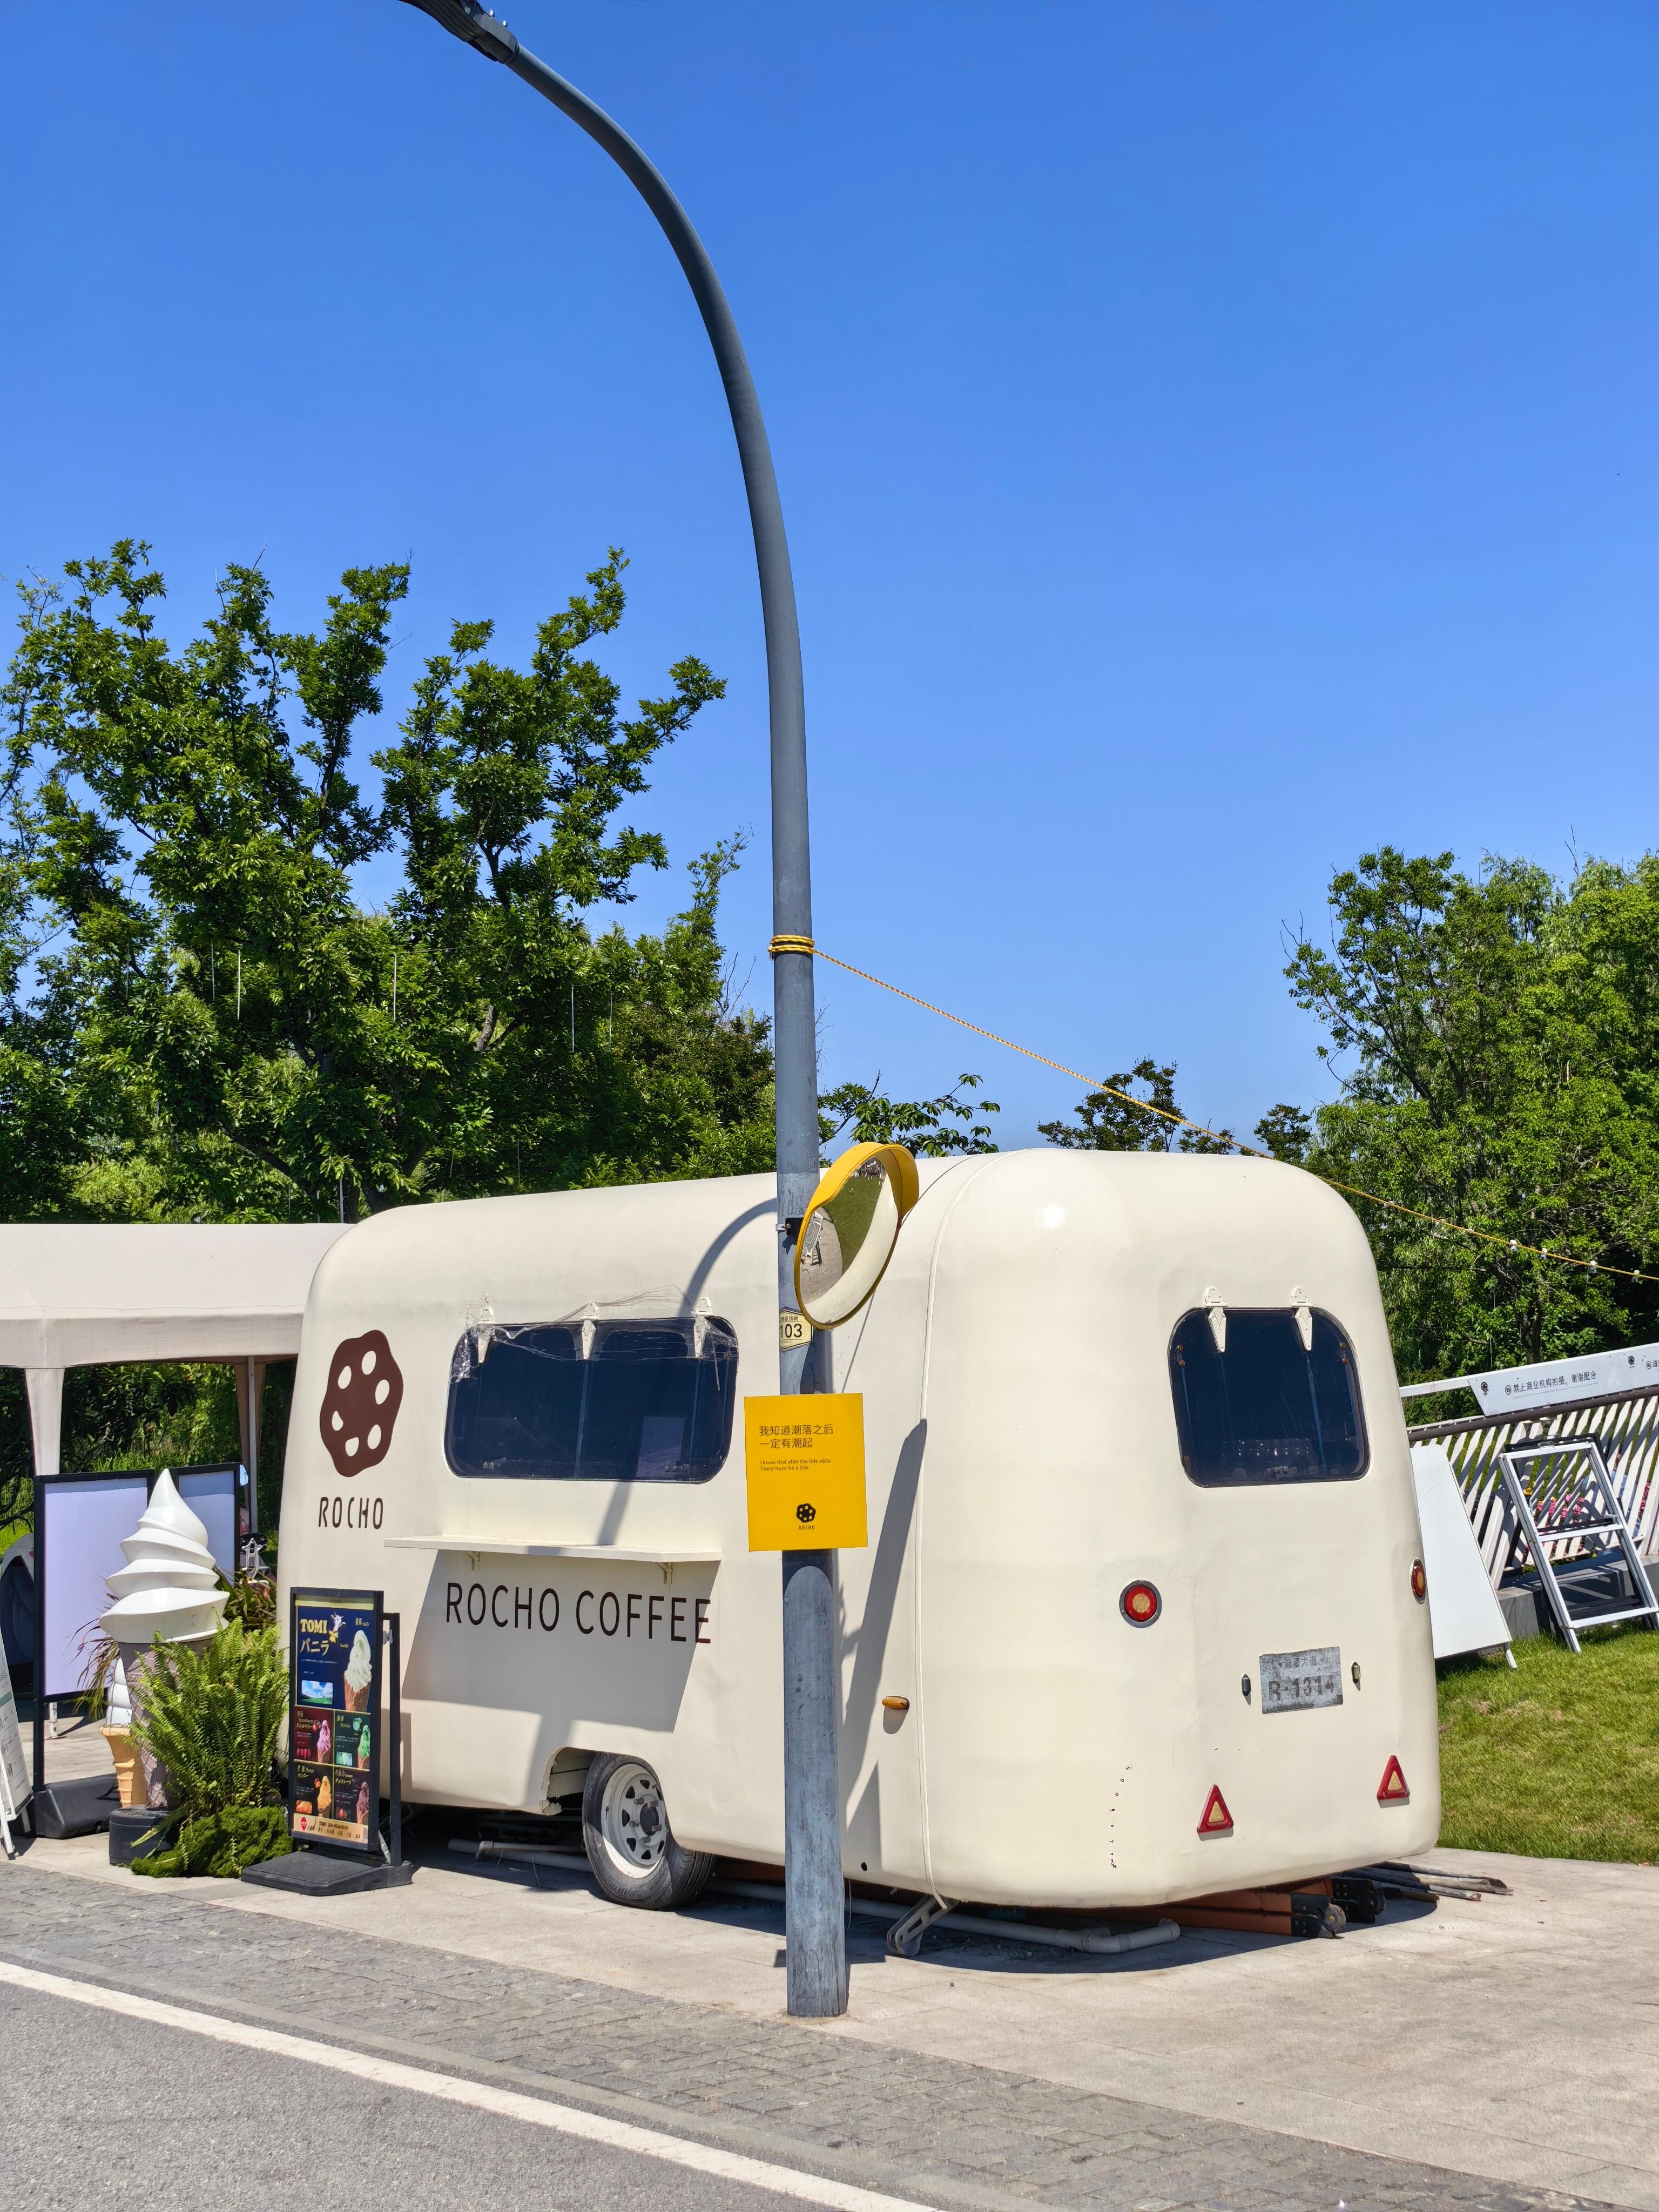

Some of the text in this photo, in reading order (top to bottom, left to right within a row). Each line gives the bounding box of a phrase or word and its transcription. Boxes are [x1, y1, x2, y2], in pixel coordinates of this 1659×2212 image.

[780, 1324, 802, 1338] 103
[759, 1424, 833, 1437] 我知道潮落之后
[760, 1438, 813, 1449] 一定有潮起
[318, 1496, 384, 1530] ROCHO
[446, 1582, 711, 1644] ROCHO COFFEE
[300, 1619, 328, 1634] TOMI
[300, 1638, 329, 1656] バニラ
